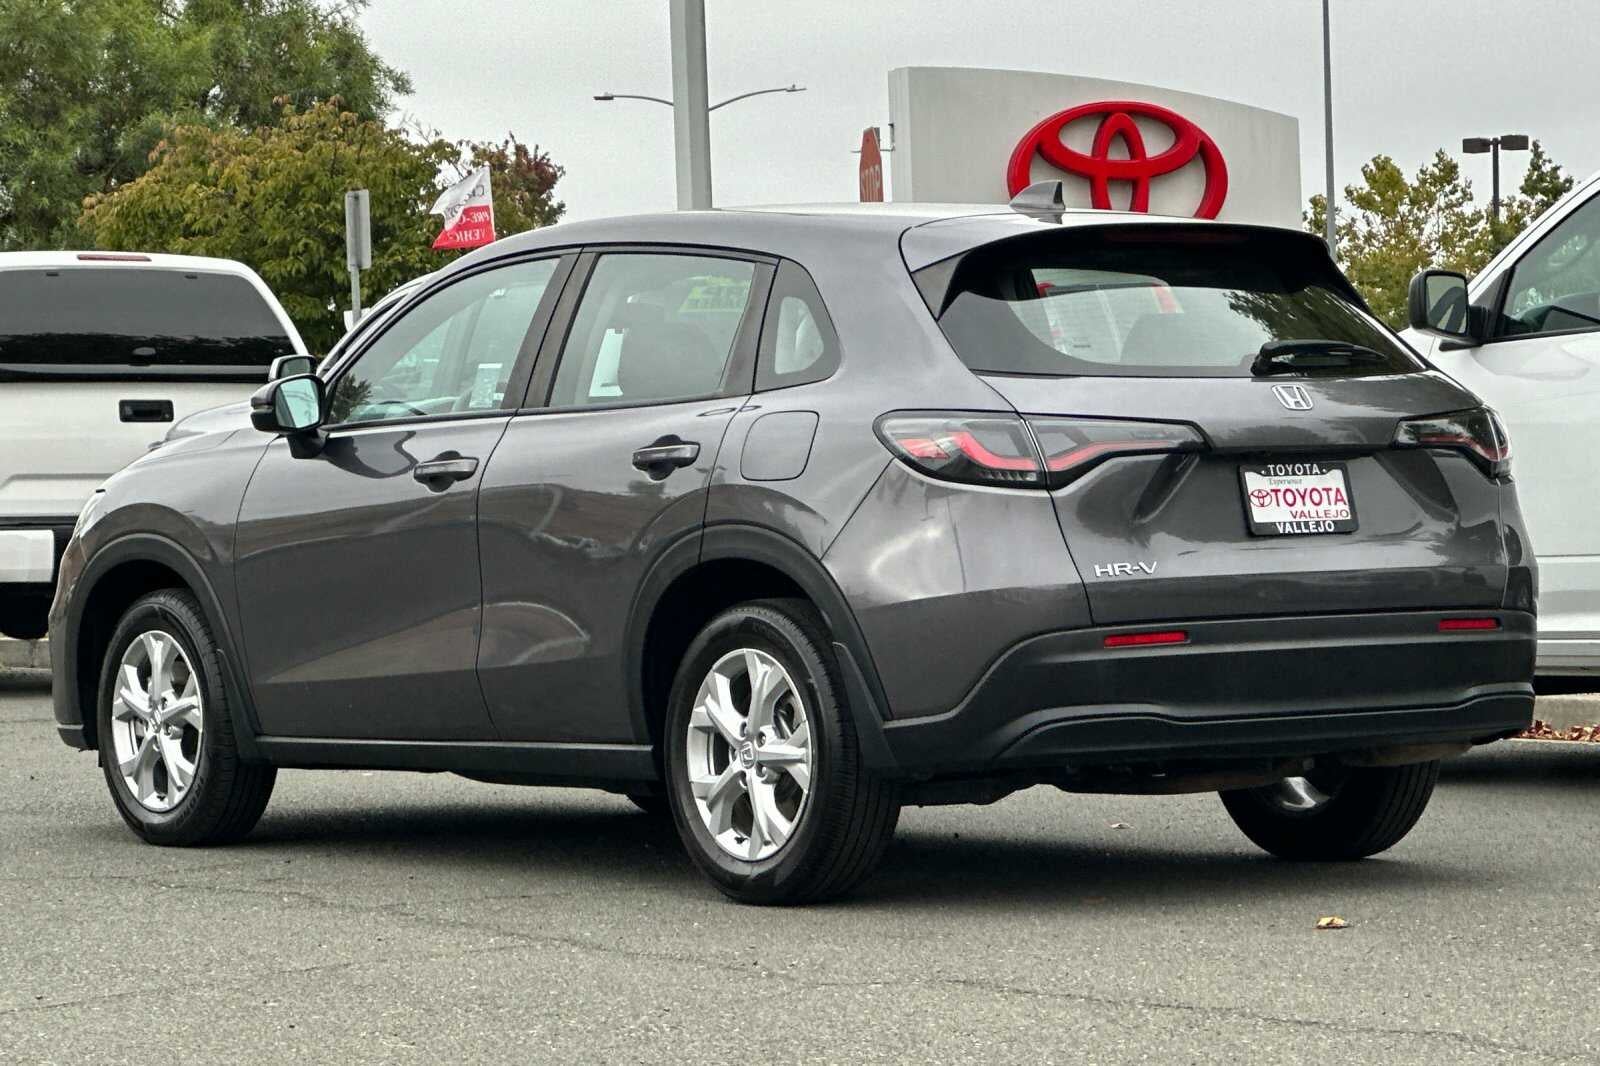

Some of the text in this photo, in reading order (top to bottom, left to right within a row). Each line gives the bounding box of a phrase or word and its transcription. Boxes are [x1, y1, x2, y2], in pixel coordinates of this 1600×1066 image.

[1267, 464, 1320, 475] TOYOTA
[1271, 488, 1347, 507] TOYOTA
[1290, 509, 1349, 519] VALLEJO
[1276, 520, 1334, 533] VALLEJO
[1094, 561, 1157, 577] HR-V
